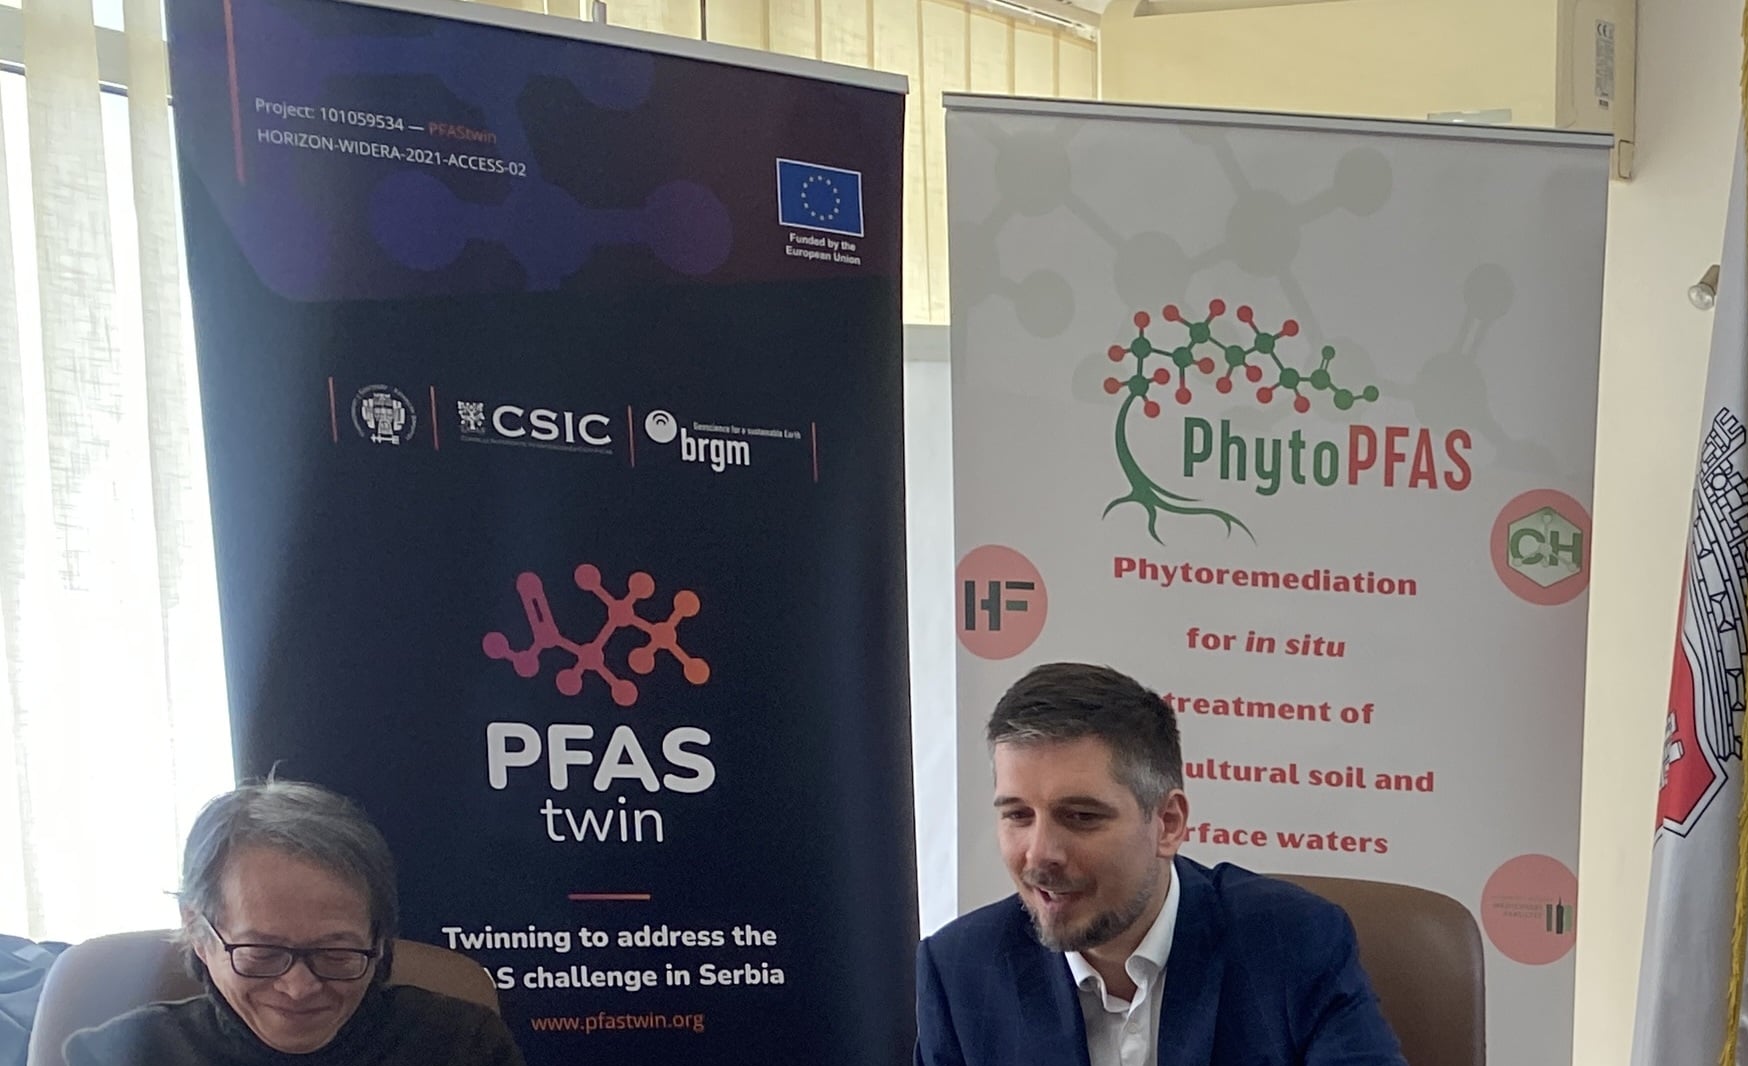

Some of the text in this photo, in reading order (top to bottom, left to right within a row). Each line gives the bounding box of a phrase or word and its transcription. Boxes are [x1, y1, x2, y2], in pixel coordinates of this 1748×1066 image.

[256, 98, 315, 120] Project:
[320, 107, 404, 132] 101059534
[428, 121, 497, 144] PFAStwin
[258, 128, 527, 177] HORIZON-WIDERA-2021-ACCESS-02
[785, 245, 861, 265] European Union
[789, 232, 856, 252] Funded by the
[492, 404, 612, 446] CSIC
[680, 427, 750, 473] brgm
[1183, 416, 1473, 496] PhytoPFAS
[1114, 556, 1418, 597] Phytoremediation
[1187, 626, 1346, 659] for in situ
[1164, 691, 1375, 725] treatment of
[486, 722, 716, 793] PFAS
[1184, 758, 1434, 793] ultural soil and
[540, 796, 664, 842] twin
[1182, 822, 1389, 855] rface waters
[442, 924, 777, 952] Twinning to address the
[524, 966, 657, 991] challenge
[666, 963, 690, 986] in
[700, 962, 785, 985] Serbia
[531, 1011, 705, 1034] www.pfastwin.org
